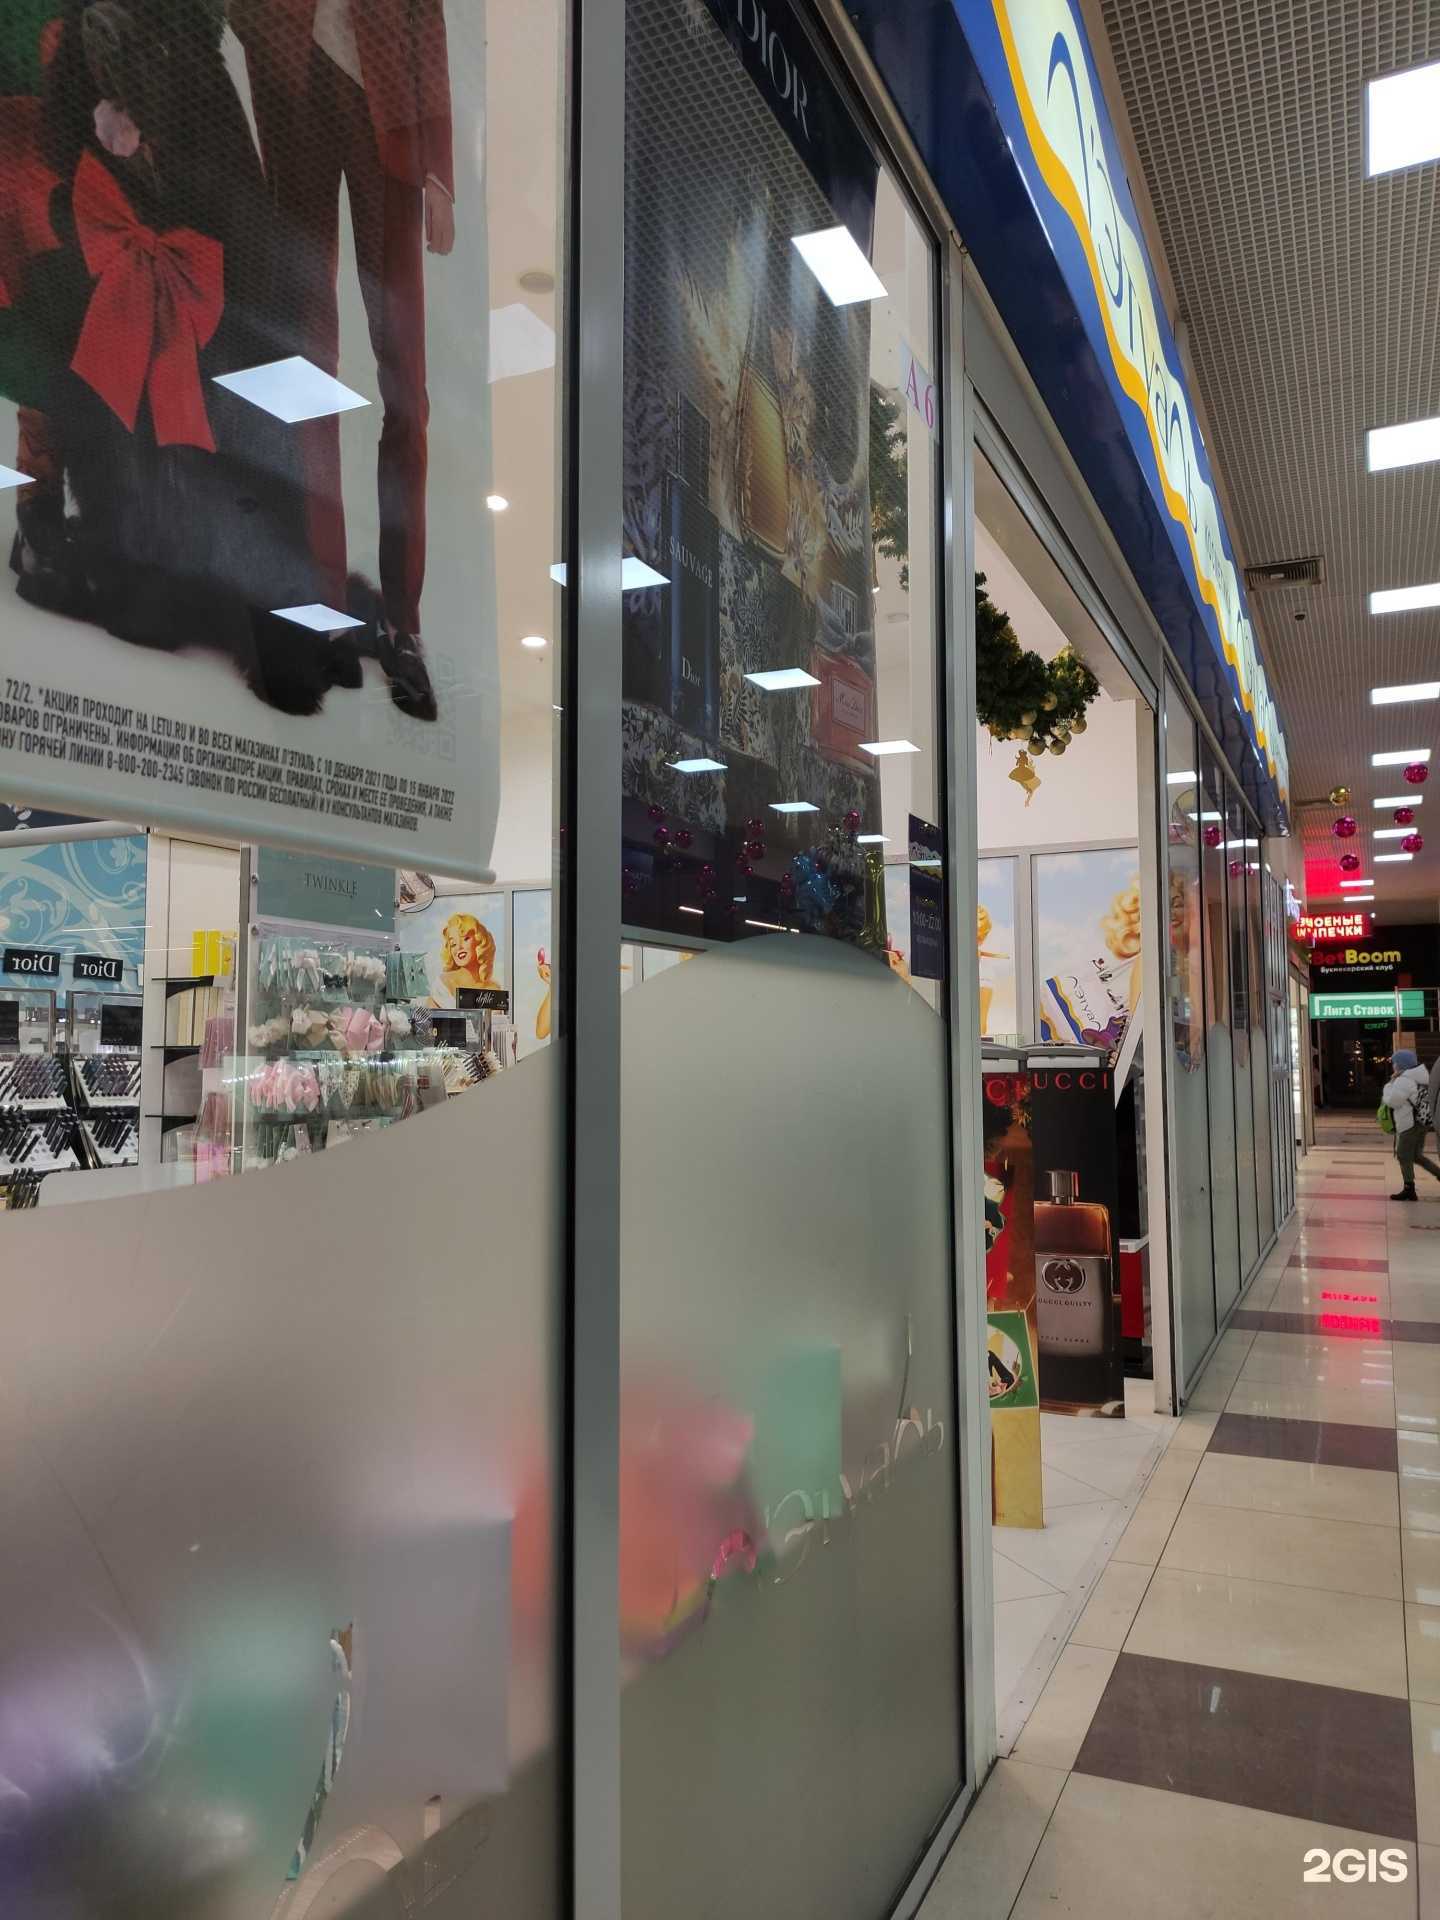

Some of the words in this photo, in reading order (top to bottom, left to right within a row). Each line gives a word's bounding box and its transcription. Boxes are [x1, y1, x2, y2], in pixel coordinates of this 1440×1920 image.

[737, 0, 811, 143] DIOR
[669, 535, 713, 588] SAUVAGE
[6, 679, 34, 704] 72/2.
[82, 698, 133, 728] ПРОХОДИТ
[136, 711, 148, 732] НА
[152, 715, 187, 740] LETU.RU
[189, 724, 195, 742] И
[199, 726, 209, 746] ВО
[212, 730, 232, 751] ВСЕХ
[235, 736, 280, 763] МАГАЗИНАХ
[334, 762, 364, 783] ДЕКАБРЯ
[365, 769, 380, 787] 2021
[43, 712, 113, 745] ОГРАНИЧЕНЫ.
[116, 729, 181, 761] ИНФОРМАЦИЯ
[183, 745, 194, 764] ОБ
[196, 748, 256, 779] ОРГАНИЗАТОРЕ
[359, 786, 379, 806] МЕСТЕ
[19, 731, 66, 760] ГОРЯЧЕЙ
[69, 742, 104, 767] ЛИНИИ
[107, 750, 184, 784] 8-800-200-2345
[186, 767, 223, 792] (ЗВОНОК
[224, 776, 235, 794] ПО
[237, 778, 268, 801] РОССИИ
[303, 872, 360, 898] TWINKLE
[1312, 949, 1402, 965] BetBoom
[1323, 1005, 1351, 1017] Лига
[1353, 1004, 1394, 1016] Ставок
[1032, 1071, 1109, 1090] UCCI
